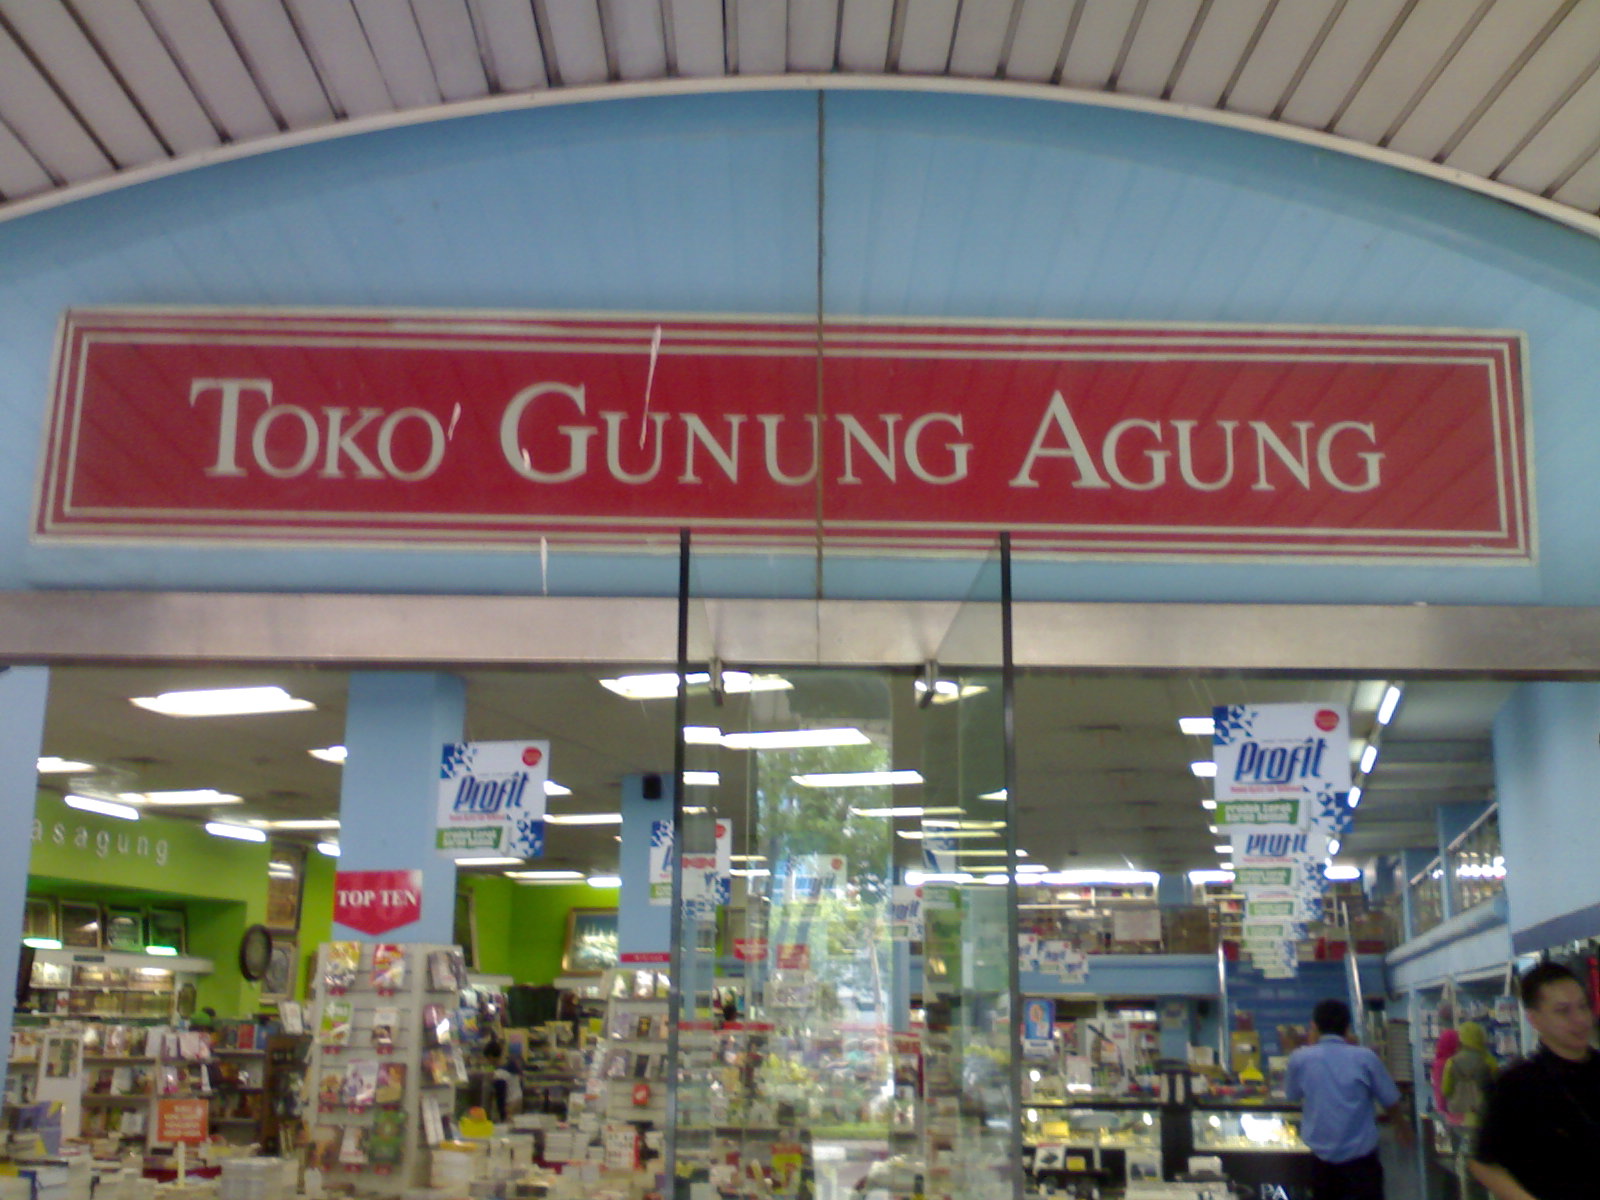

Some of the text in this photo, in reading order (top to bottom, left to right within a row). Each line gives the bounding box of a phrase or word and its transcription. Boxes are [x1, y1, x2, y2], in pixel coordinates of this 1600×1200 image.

[189, 377, 1385, 492] TOKO GUNUNG AGUNG
[1233, 737, 1327, 784] Profit
[452, 771, 529, 813] Profit
[337, 889, 417, 907] TOP TEN
